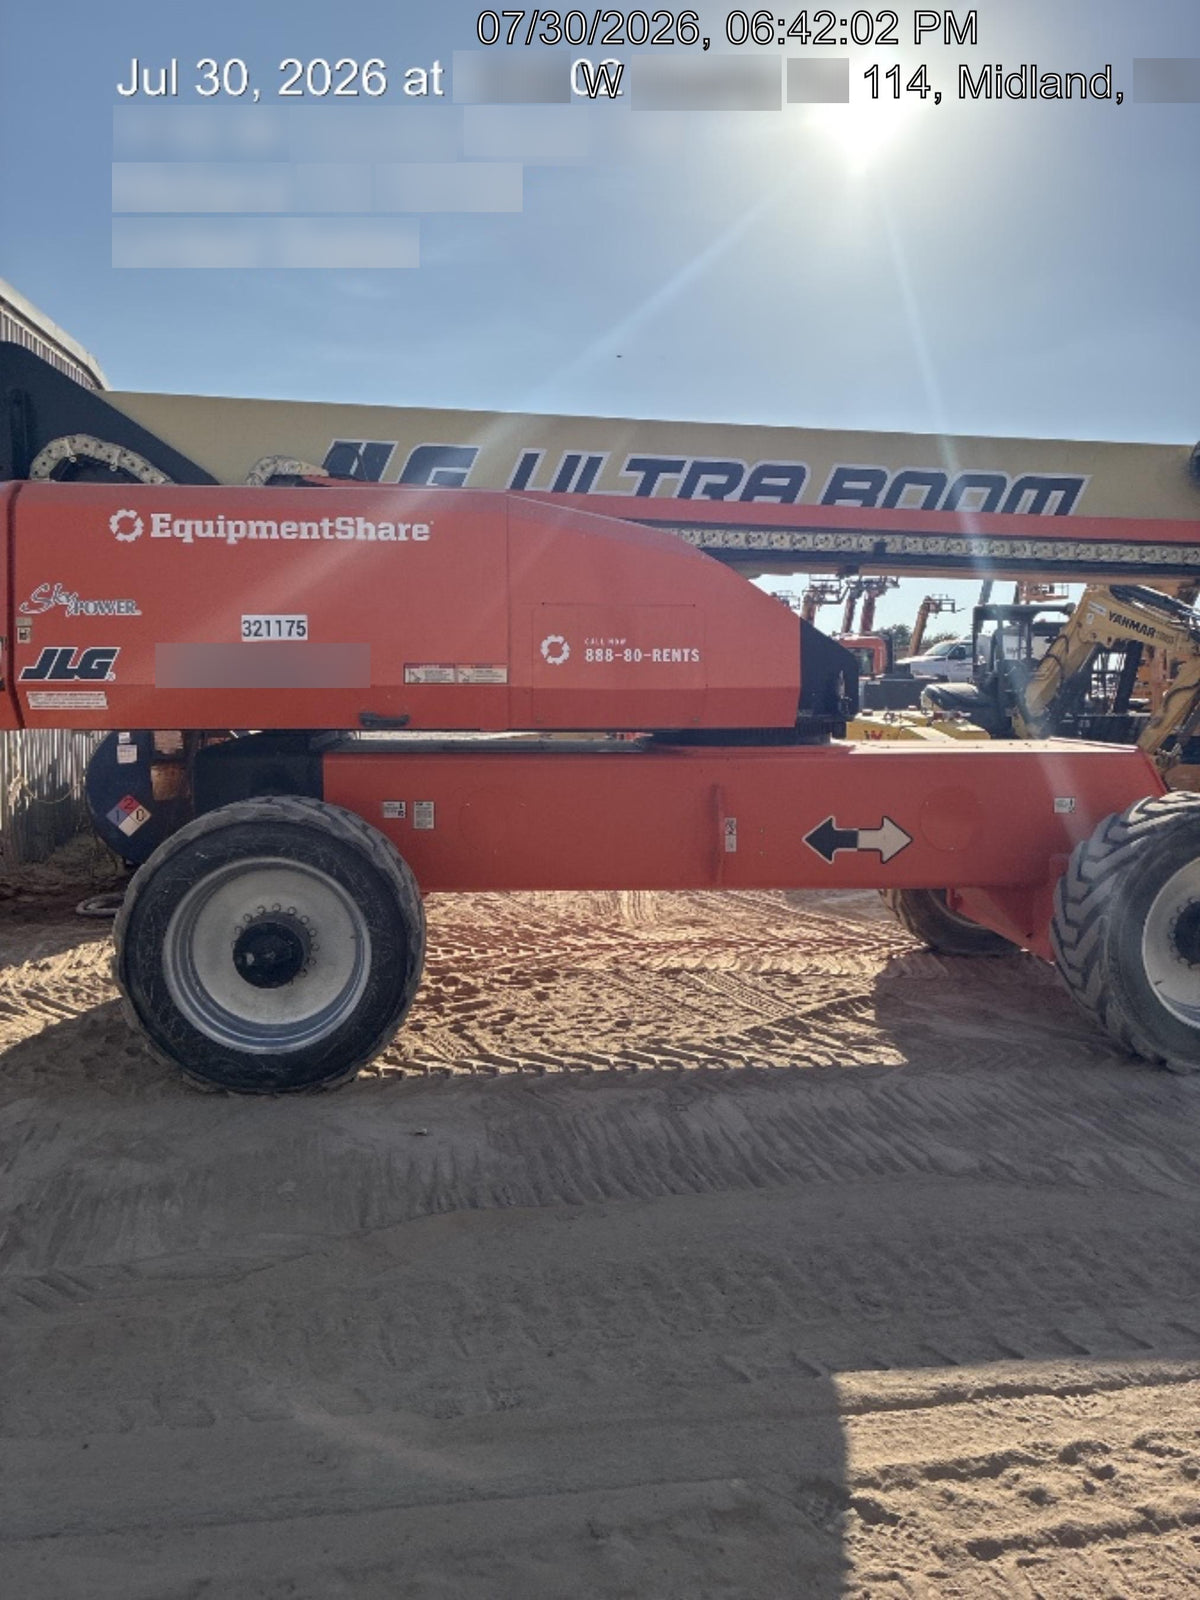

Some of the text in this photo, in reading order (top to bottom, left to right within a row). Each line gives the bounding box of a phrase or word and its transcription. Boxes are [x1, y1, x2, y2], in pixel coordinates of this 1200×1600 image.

[504, 447, 812, 505] ULTRA
[150, 511, 433, 545] EquipmentShare
[241, 616, 308, 641] 321175
[1108, 610, 1158, 639] YANMAR
[584, 637, 605, 646] CALL
[584, 647, 701, 663] 888-80-RENTS
[18, 646, 121, 682] JLG
[123, 797, 135, 810] 2
